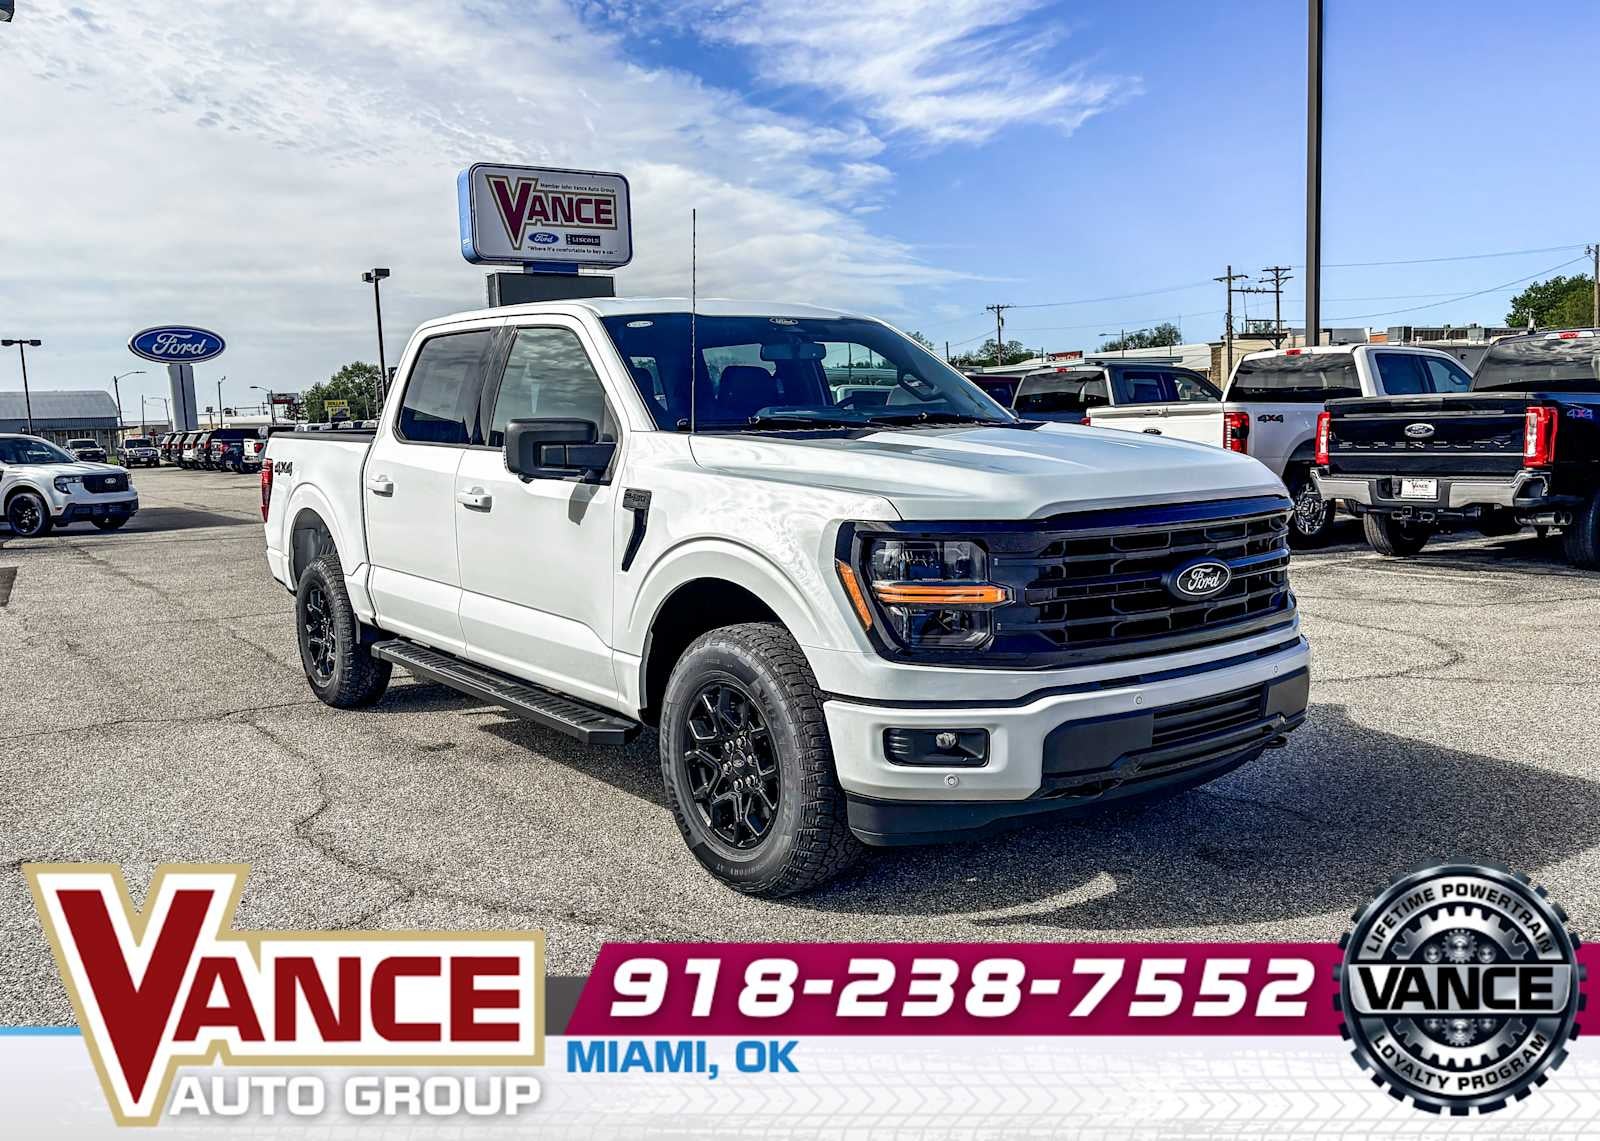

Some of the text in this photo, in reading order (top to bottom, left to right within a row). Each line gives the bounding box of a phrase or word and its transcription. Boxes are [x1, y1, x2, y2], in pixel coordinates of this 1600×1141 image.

[493, 180, 613, 245] VANCE
[534, 233, 554, 243] Ford
[151, 333, 207, 356] Ford
[1187, 567, 1220, 590] Ford
